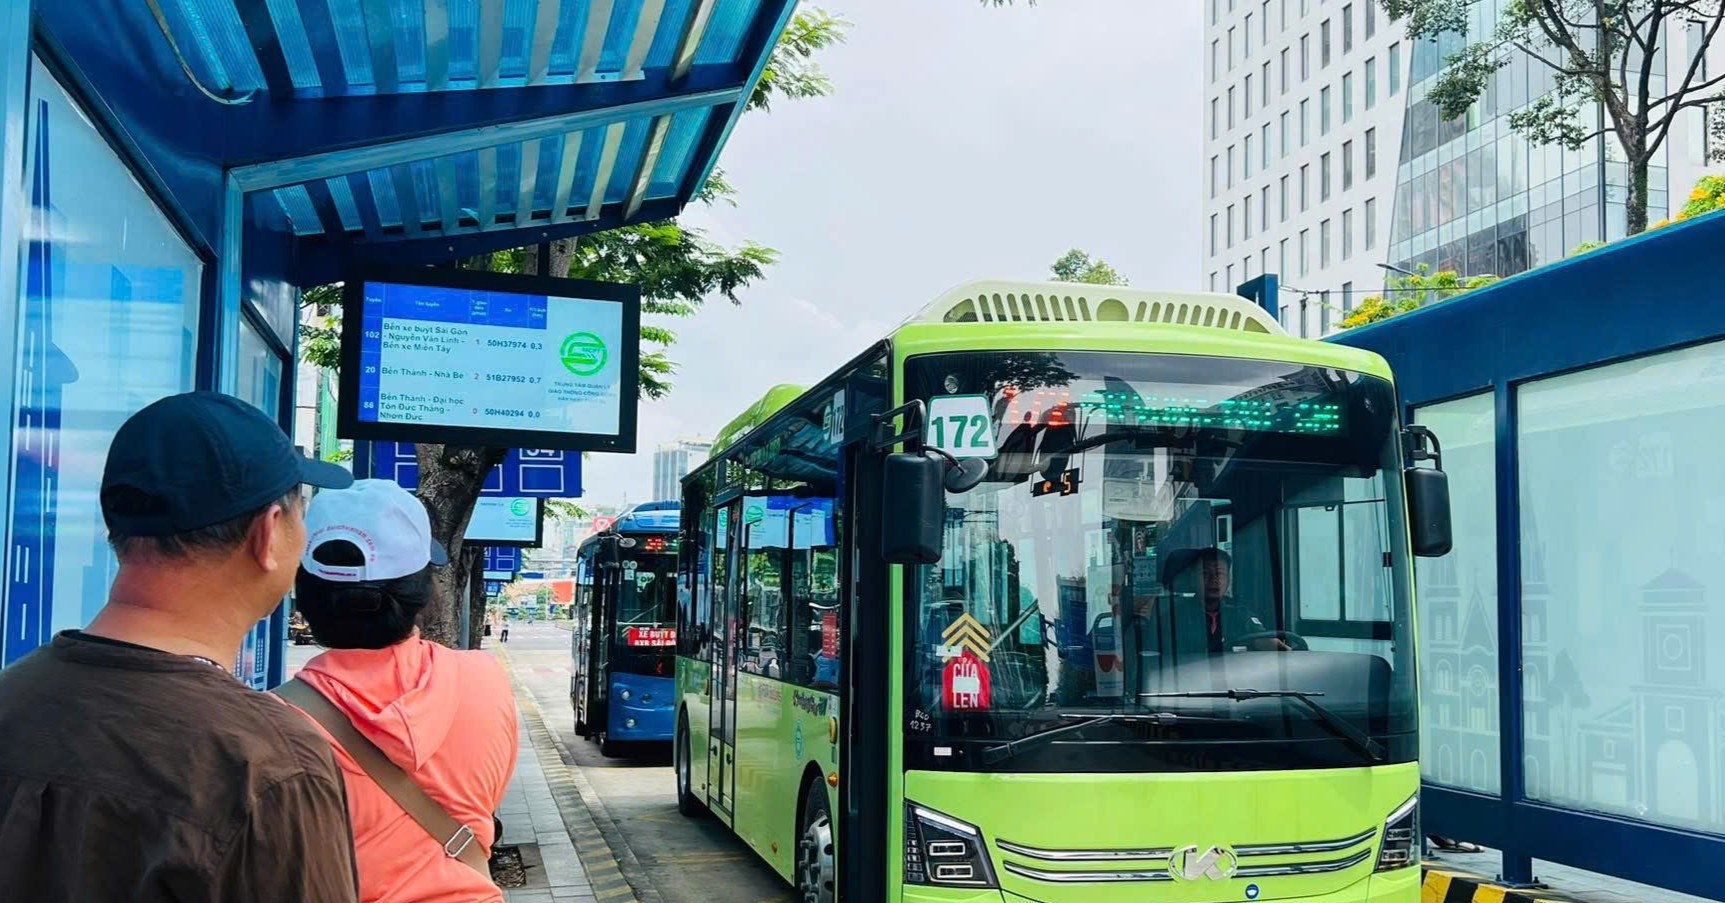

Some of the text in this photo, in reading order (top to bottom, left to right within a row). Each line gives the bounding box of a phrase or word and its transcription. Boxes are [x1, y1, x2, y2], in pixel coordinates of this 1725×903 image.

[365, 330, 380, 338] 102
[441, 335, 459, 344] Linh
[487, 339, 527, 349] 50H37974
[365, 366, 376, 374] 20
[486, 373, 526, 383] 51B27952
[485, 408, 525, 417] 50H40294
[931, 414, 989, 449] 172
[639, 630, 648, 638] XE
